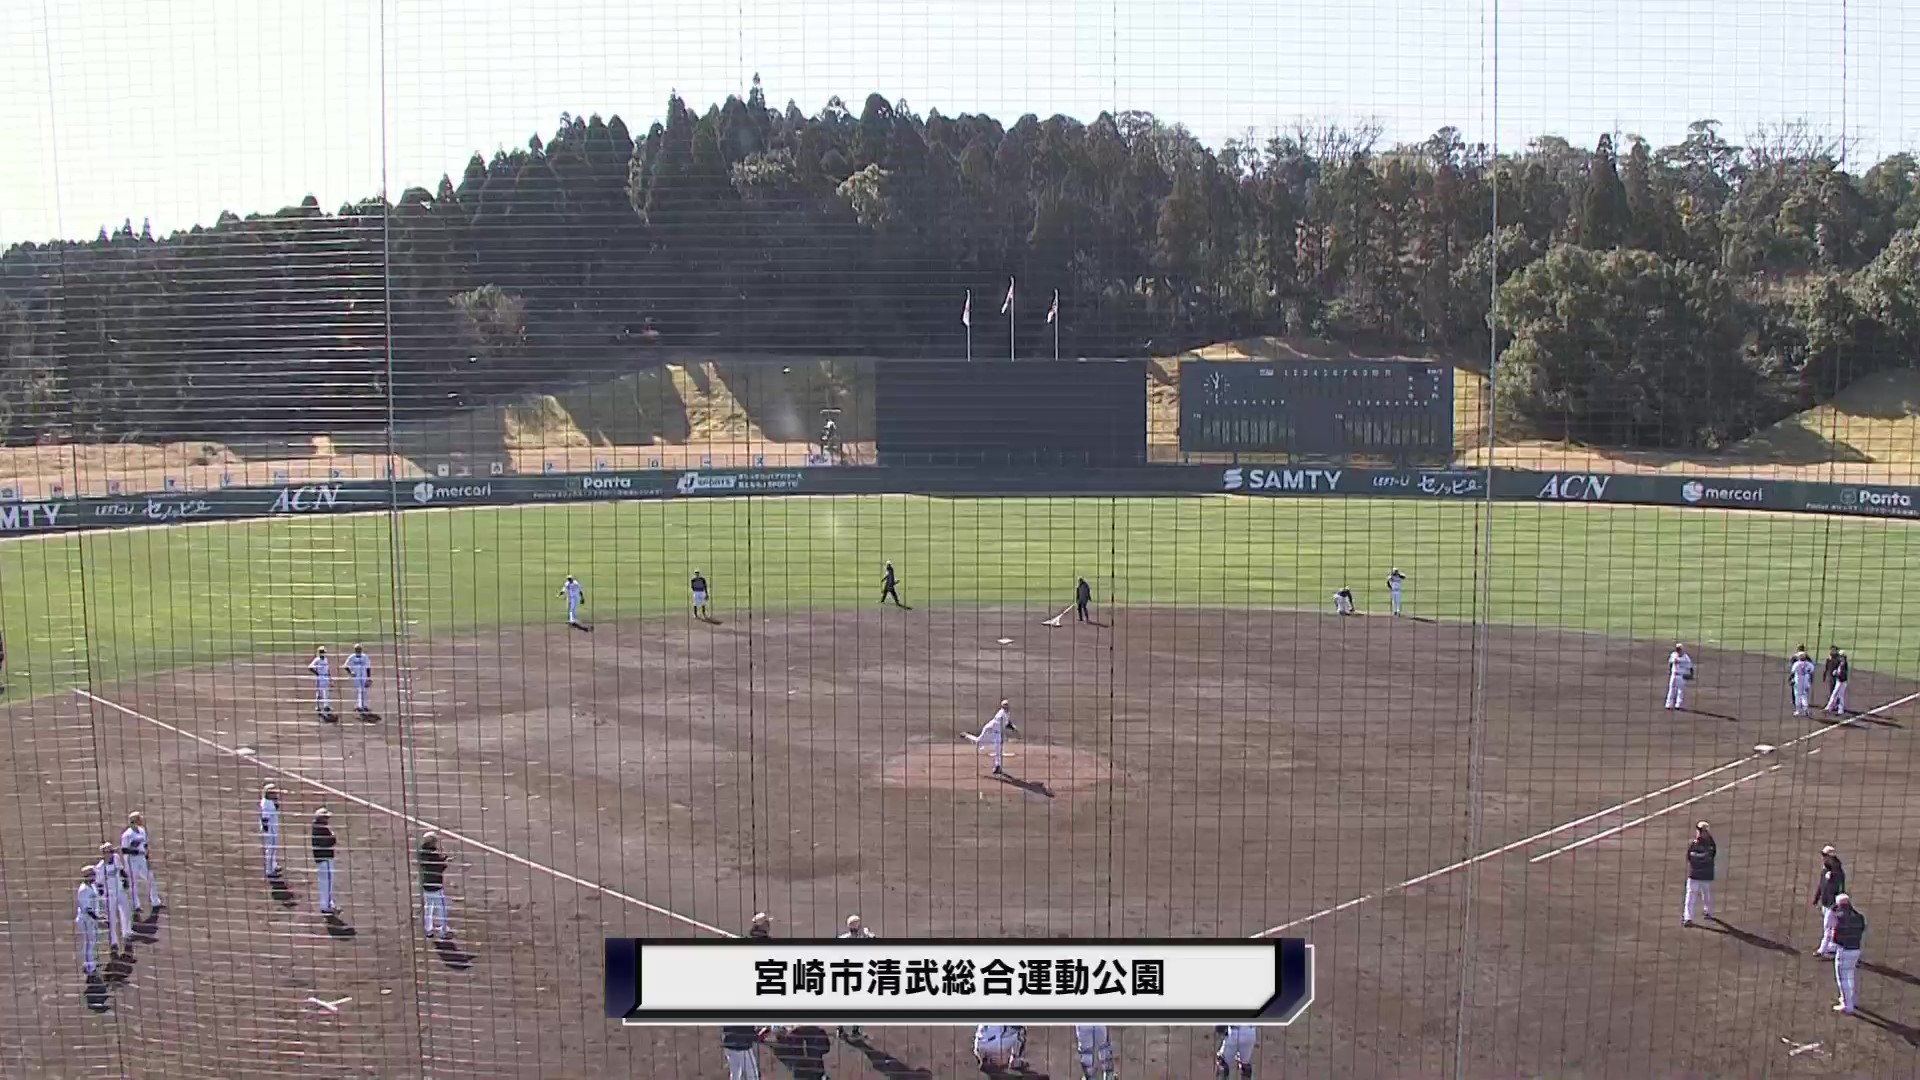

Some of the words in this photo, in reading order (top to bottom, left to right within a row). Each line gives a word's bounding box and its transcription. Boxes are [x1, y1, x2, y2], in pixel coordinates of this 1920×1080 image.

[583, 476, 631, 489] Ponta
[1249, 469, 1342, 490] SAMTY
[1537, 475, 1611, 500] ACN
[269, 485, 342, 513] ACN
[436, 482, 491, 498] mercari
[1706, 487, 1762, 502] mercari
[1860, 490, 1911, 506] Ponta
[0, 503, 61, 529] MTY
